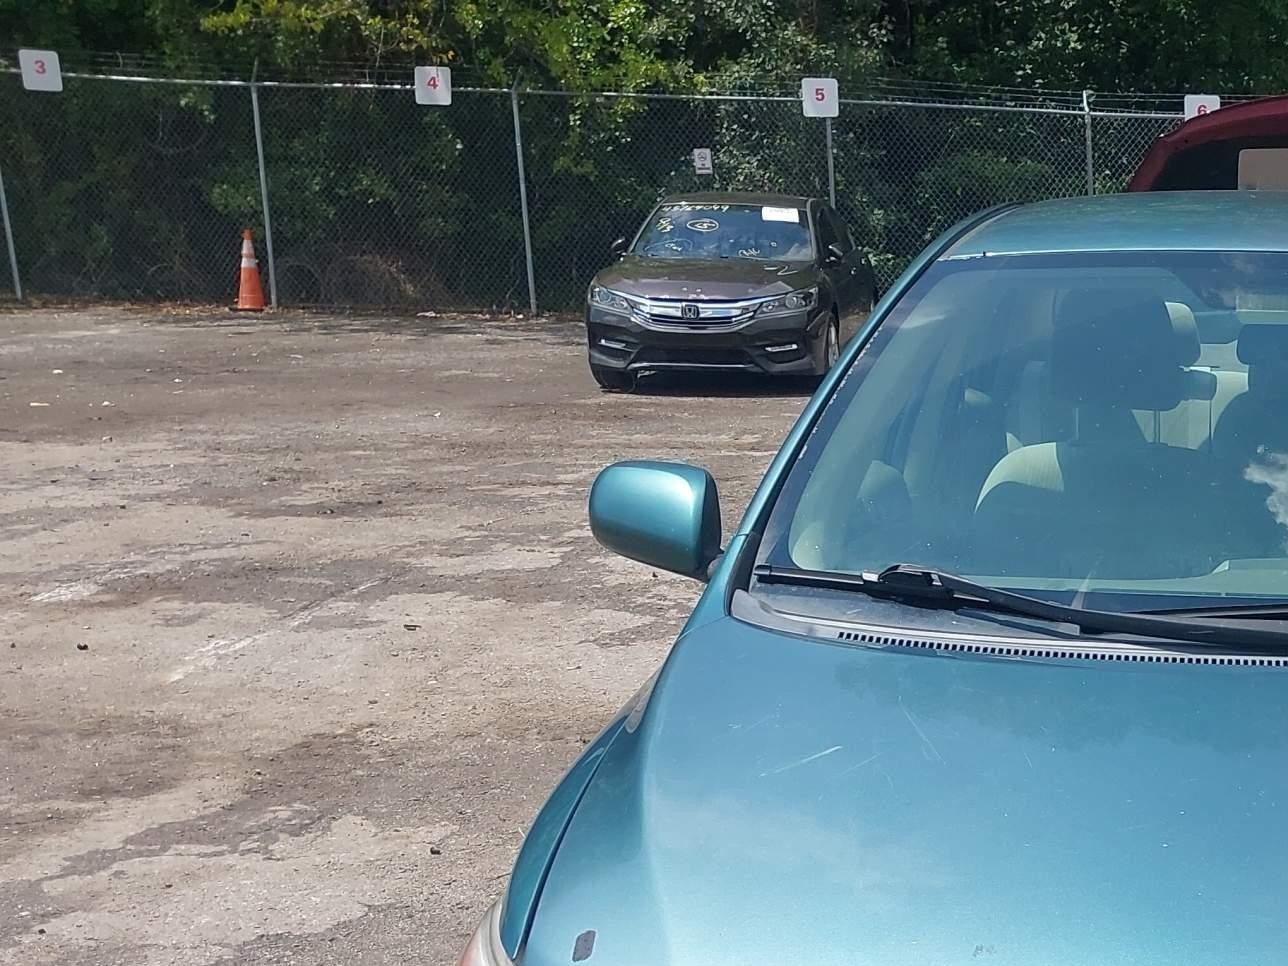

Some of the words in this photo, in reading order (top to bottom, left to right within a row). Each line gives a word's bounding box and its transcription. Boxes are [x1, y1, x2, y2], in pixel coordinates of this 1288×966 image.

[34, 60, 46, 75] 3
[427, 76, 439, 90] 4
[815, 87, 825, 102] 5
[1197, 104, 1207, 116] 6
